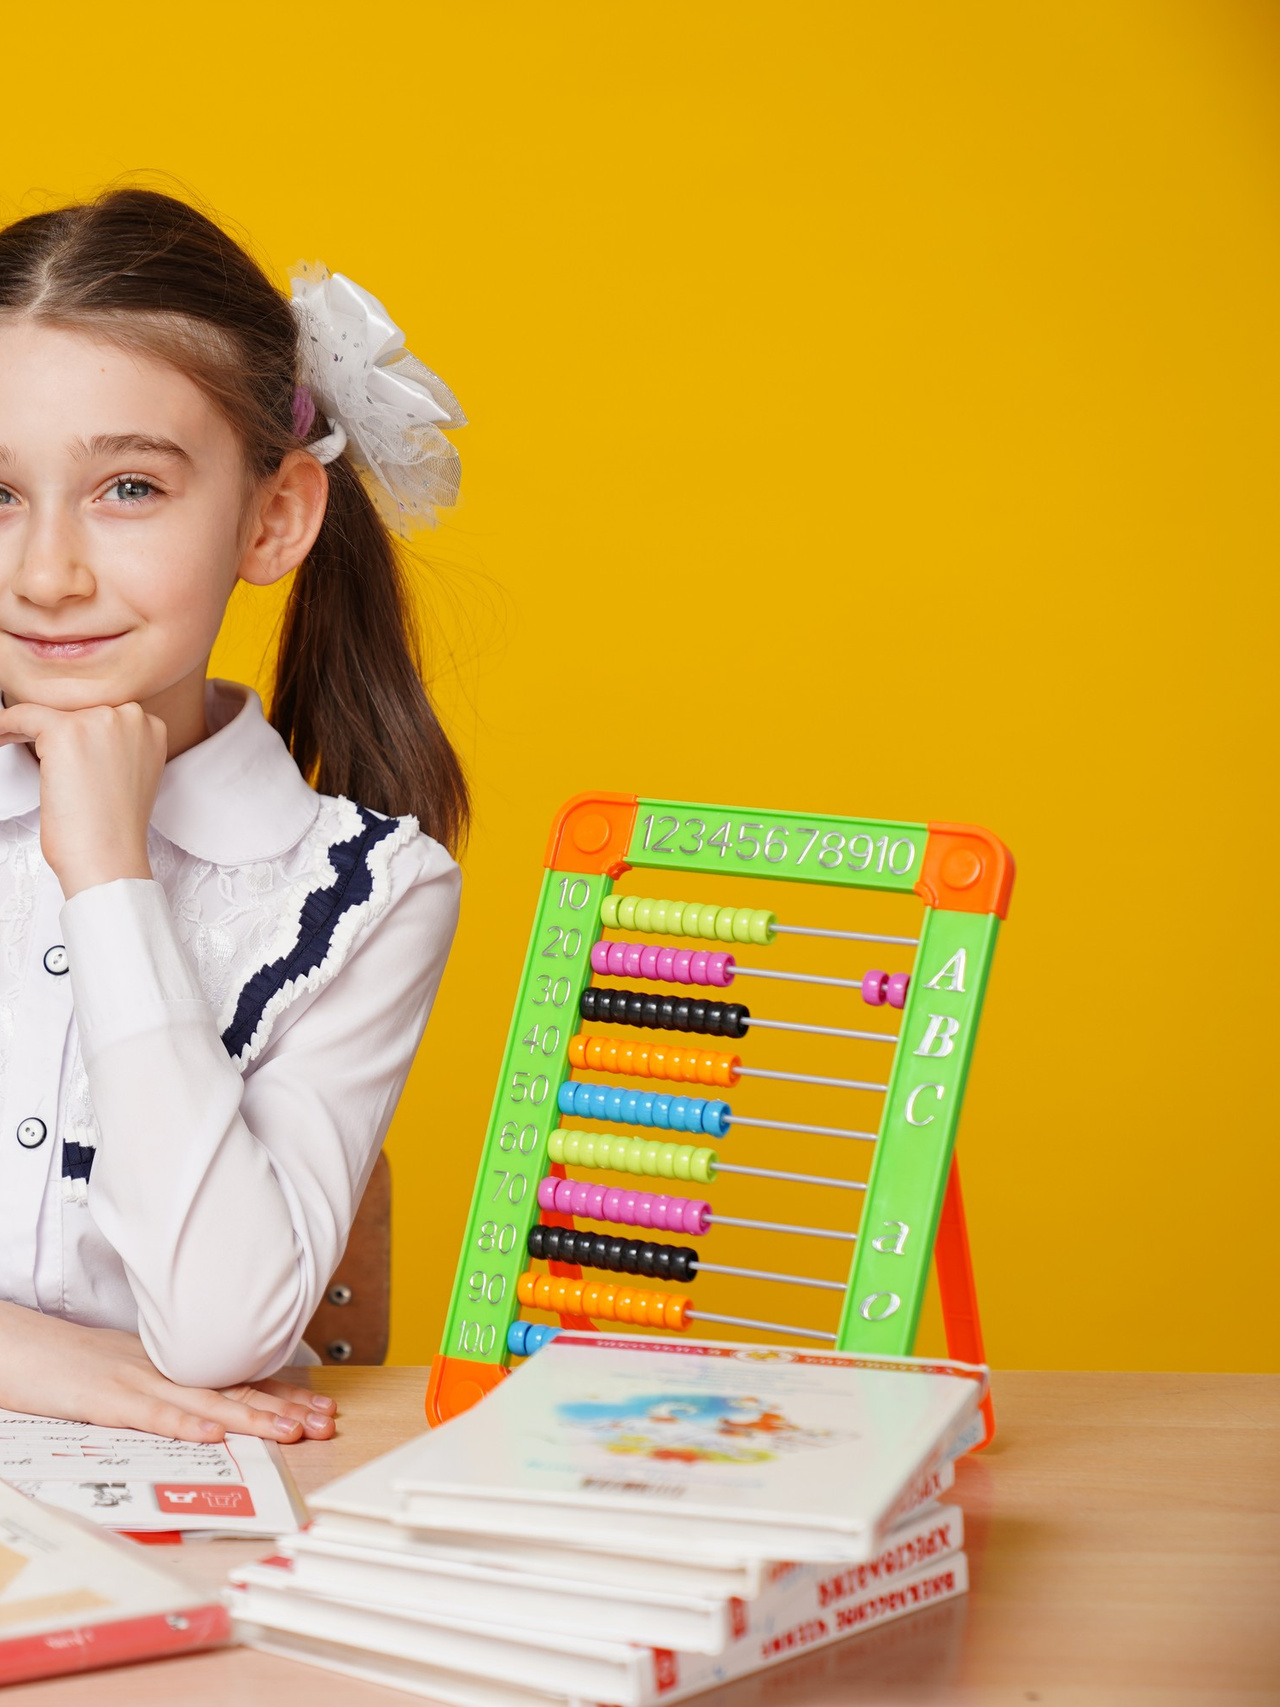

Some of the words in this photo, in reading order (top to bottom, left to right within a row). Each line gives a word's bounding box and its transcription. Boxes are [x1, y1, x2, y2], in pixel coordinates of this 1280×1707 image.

[558, 878, 590, 910] 10
[542, 925, 582, 959] 20
[922, 947, 966, 993] A
[532, 974, 571, 1008] 30
[522, 1024, 560, 1056] 40
[913, 1013, 959, 1058] B
[510, 1072, 549, 1106] 50
[905, 1082, 945, 1126] C
[499, 1121, 538, 1155] 60
[492, 1170, 527, 1204] 70
[478, 1220, 517, 1254] 80
[871, 1221, 909, 1255] a
[468, 1271, 506, 1305] 90
[457, 1320, 496, 1356] 100
